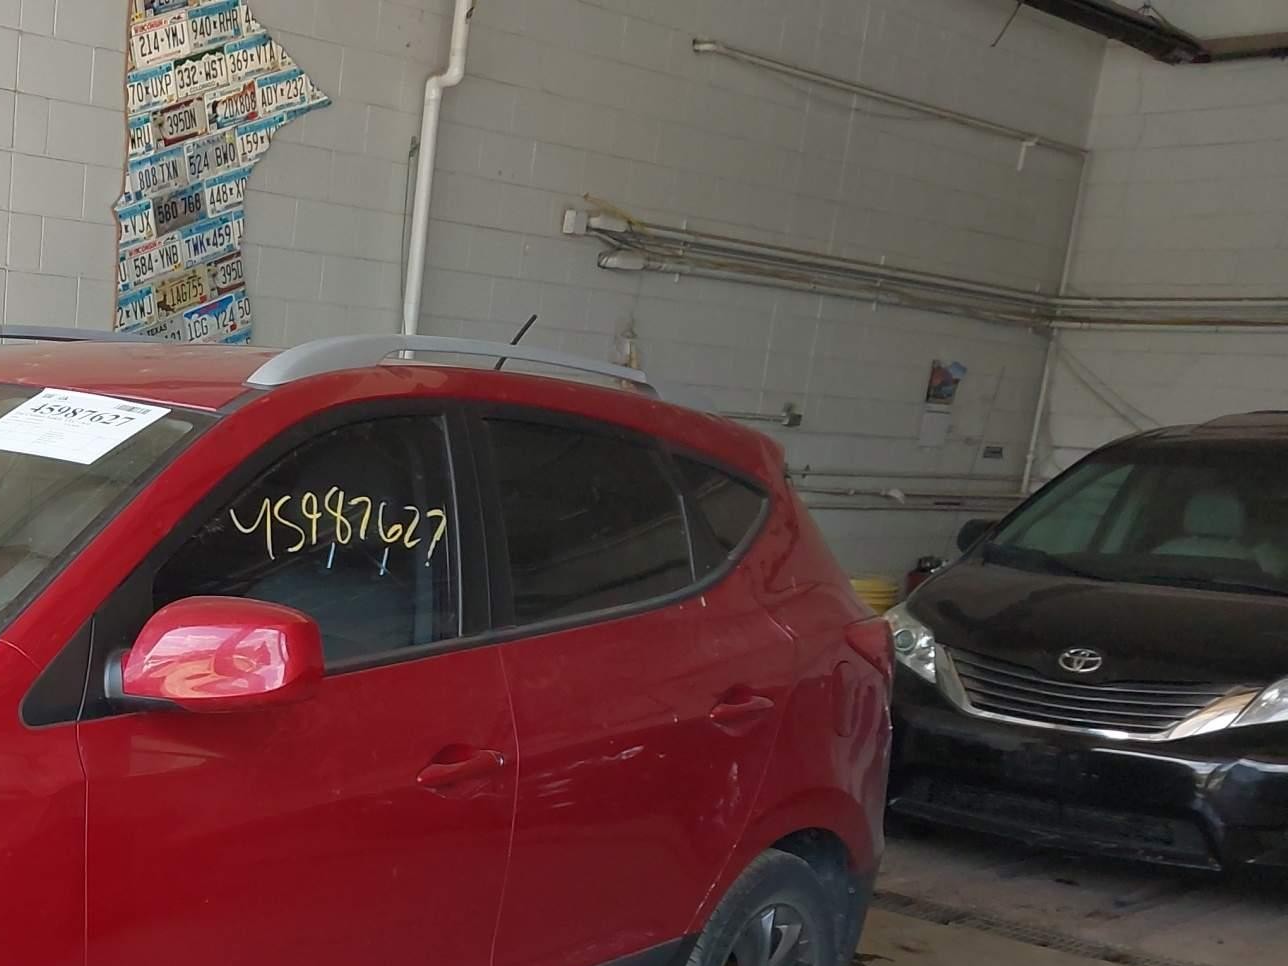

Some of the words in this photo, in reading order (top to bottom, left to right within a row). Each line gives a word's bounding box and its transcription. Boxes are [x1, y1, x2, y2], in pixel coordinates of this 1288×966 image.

[192, 16, 212, 40] 940
[229, 49, 249, 74] 369
[151, 74, 172, 98] UXP
[286, 77, 305, 100] 232
[241, 132, 259, 156] 159
[189, 151, 210, 176] 524
[139, 166, 158, 191] 808
[210, 183, 229, 208] 448
[130, 210, 153, 236] VJX
[185, 232, 207, 259] TWK
[212, 224, 232, 249] 459
[146, 322, 168, 337] TEXAS
[30, 402, 137, 427] 45987627
[230, 486, 447, 565] 45987627
